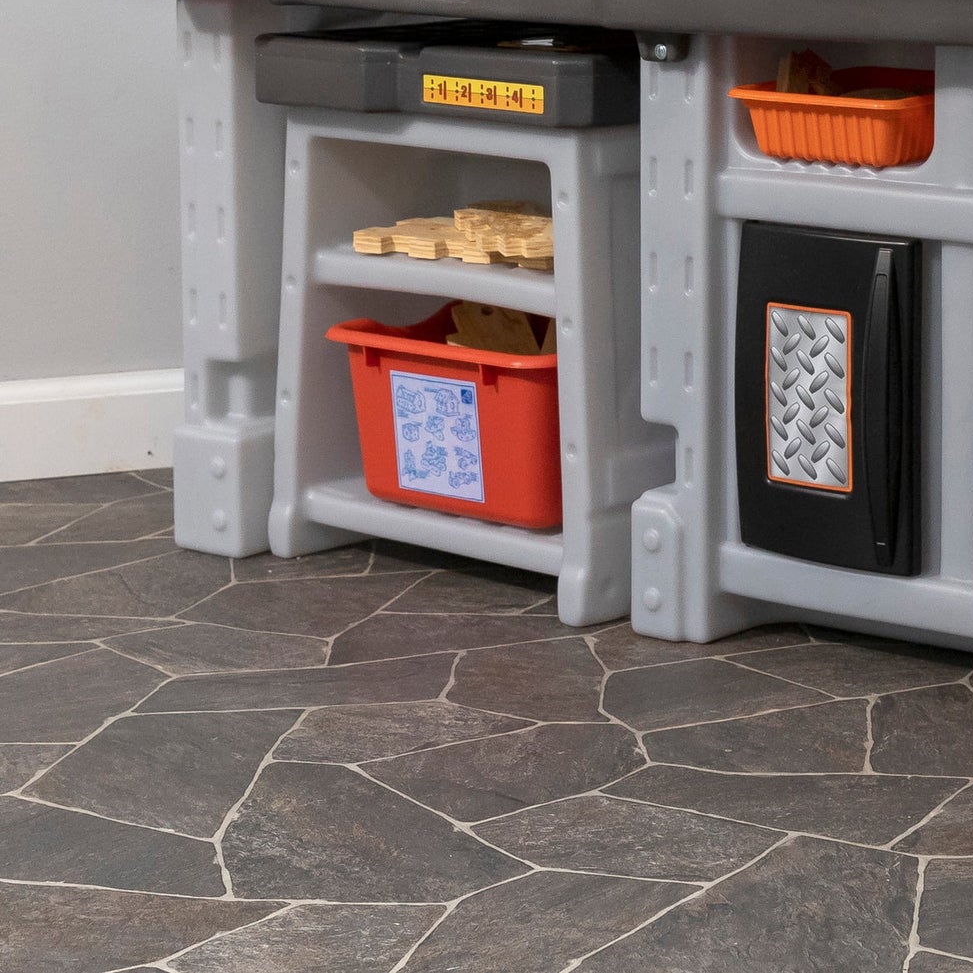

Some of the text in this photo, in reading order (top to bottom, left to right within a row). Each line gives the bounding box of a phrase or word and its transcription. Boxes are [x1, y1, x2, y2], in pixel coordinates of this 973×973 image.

[437, 83, 519, 103] 1 2 3 4
